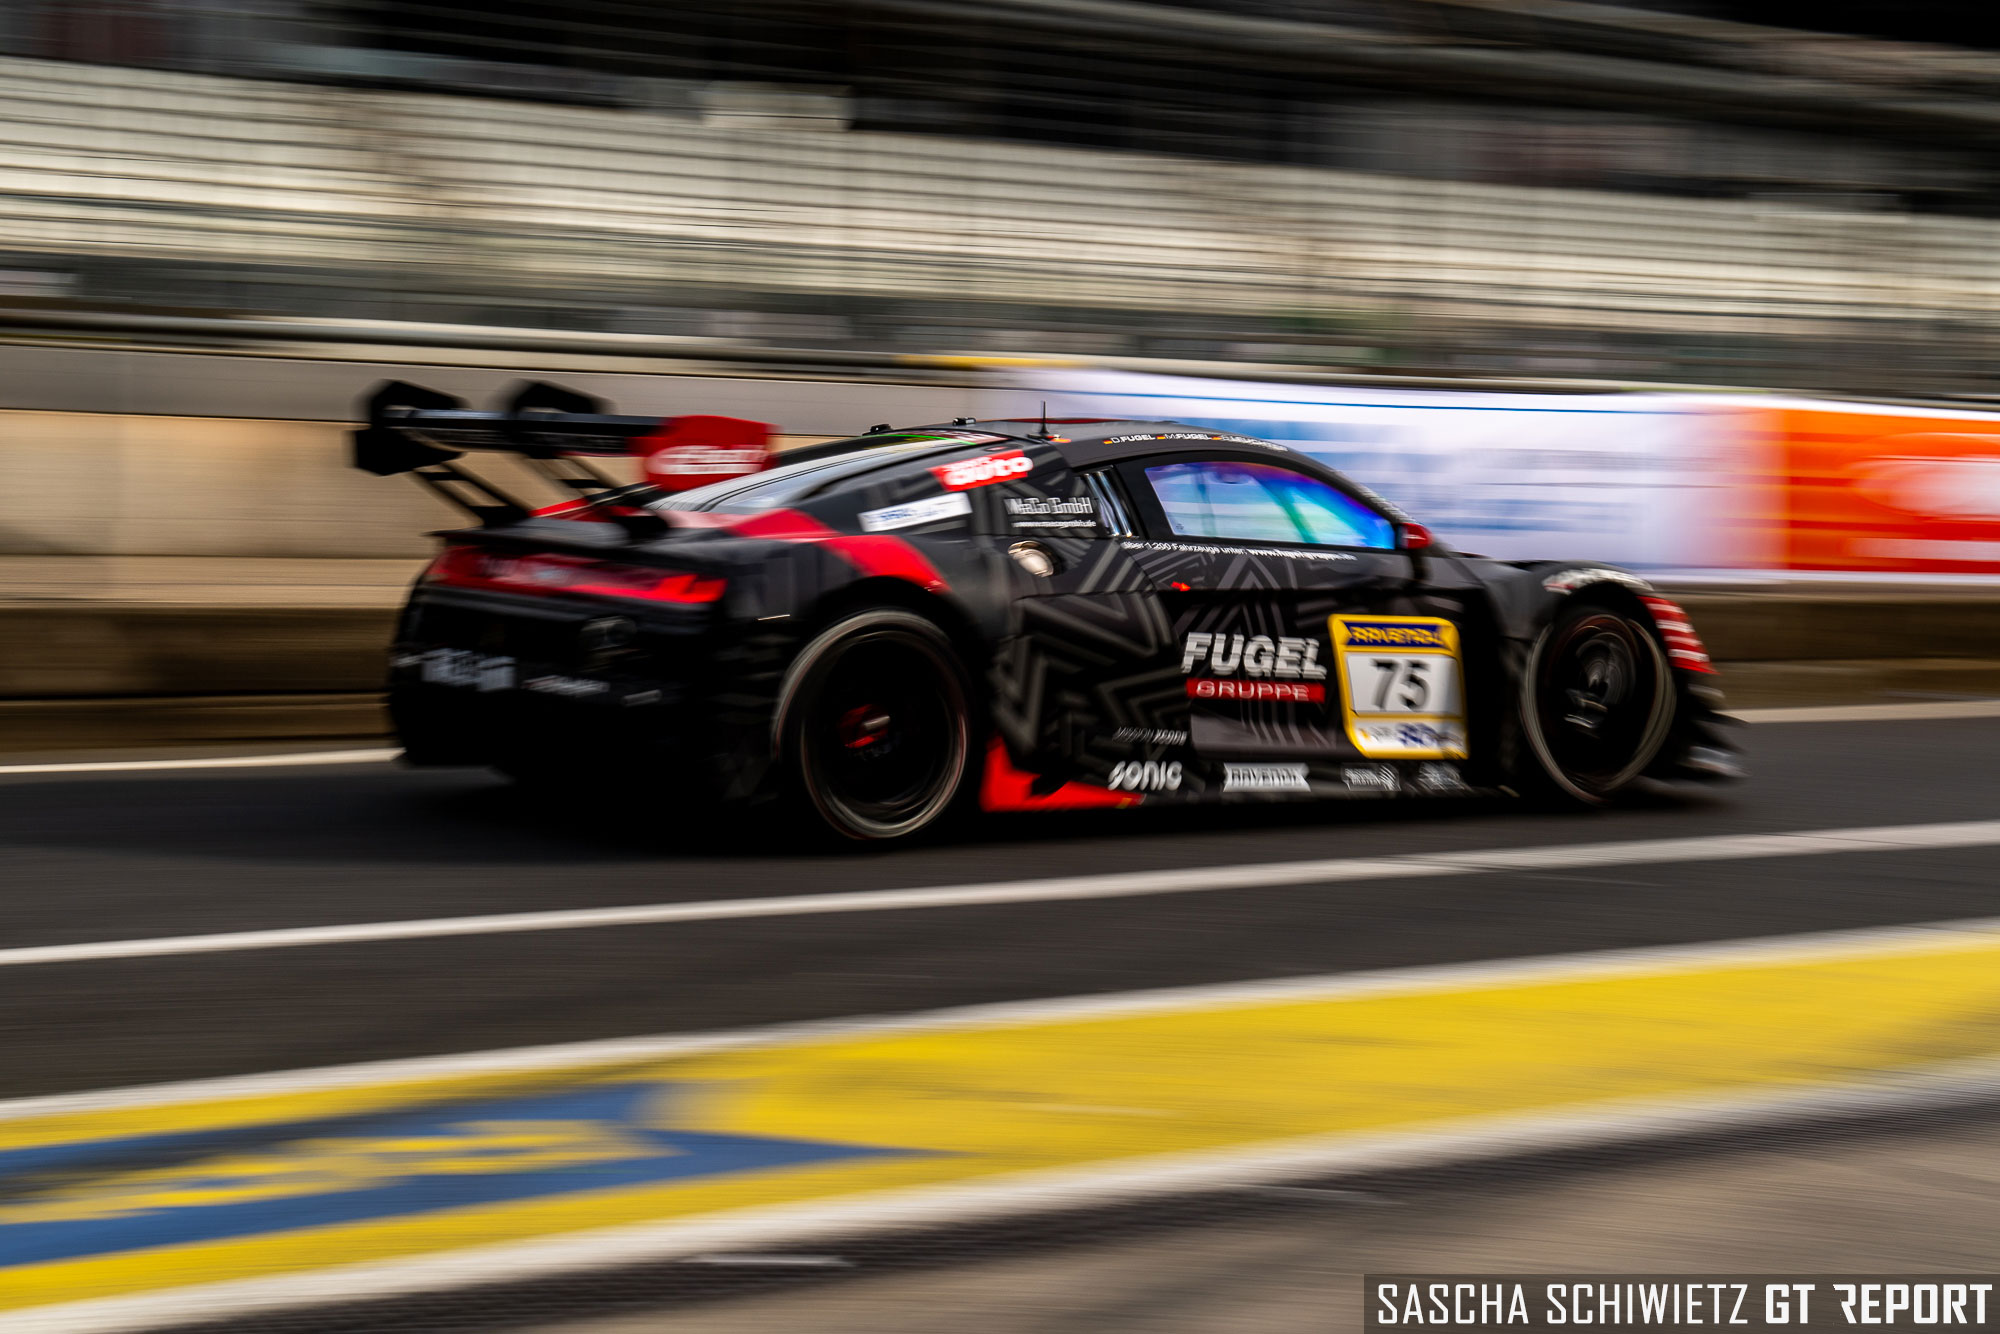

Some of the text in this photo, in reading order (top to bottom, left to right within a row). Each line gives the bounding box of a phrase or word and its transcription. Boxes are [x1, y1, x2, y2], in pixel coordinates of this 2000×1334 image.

[1048, 496, 1094, 514] GmbH
[1180, 631, 1327, 680] FUGEL
[1195, 680, 1310, 702] GRUPPE
[1371, 658, 1431, 712] 75
